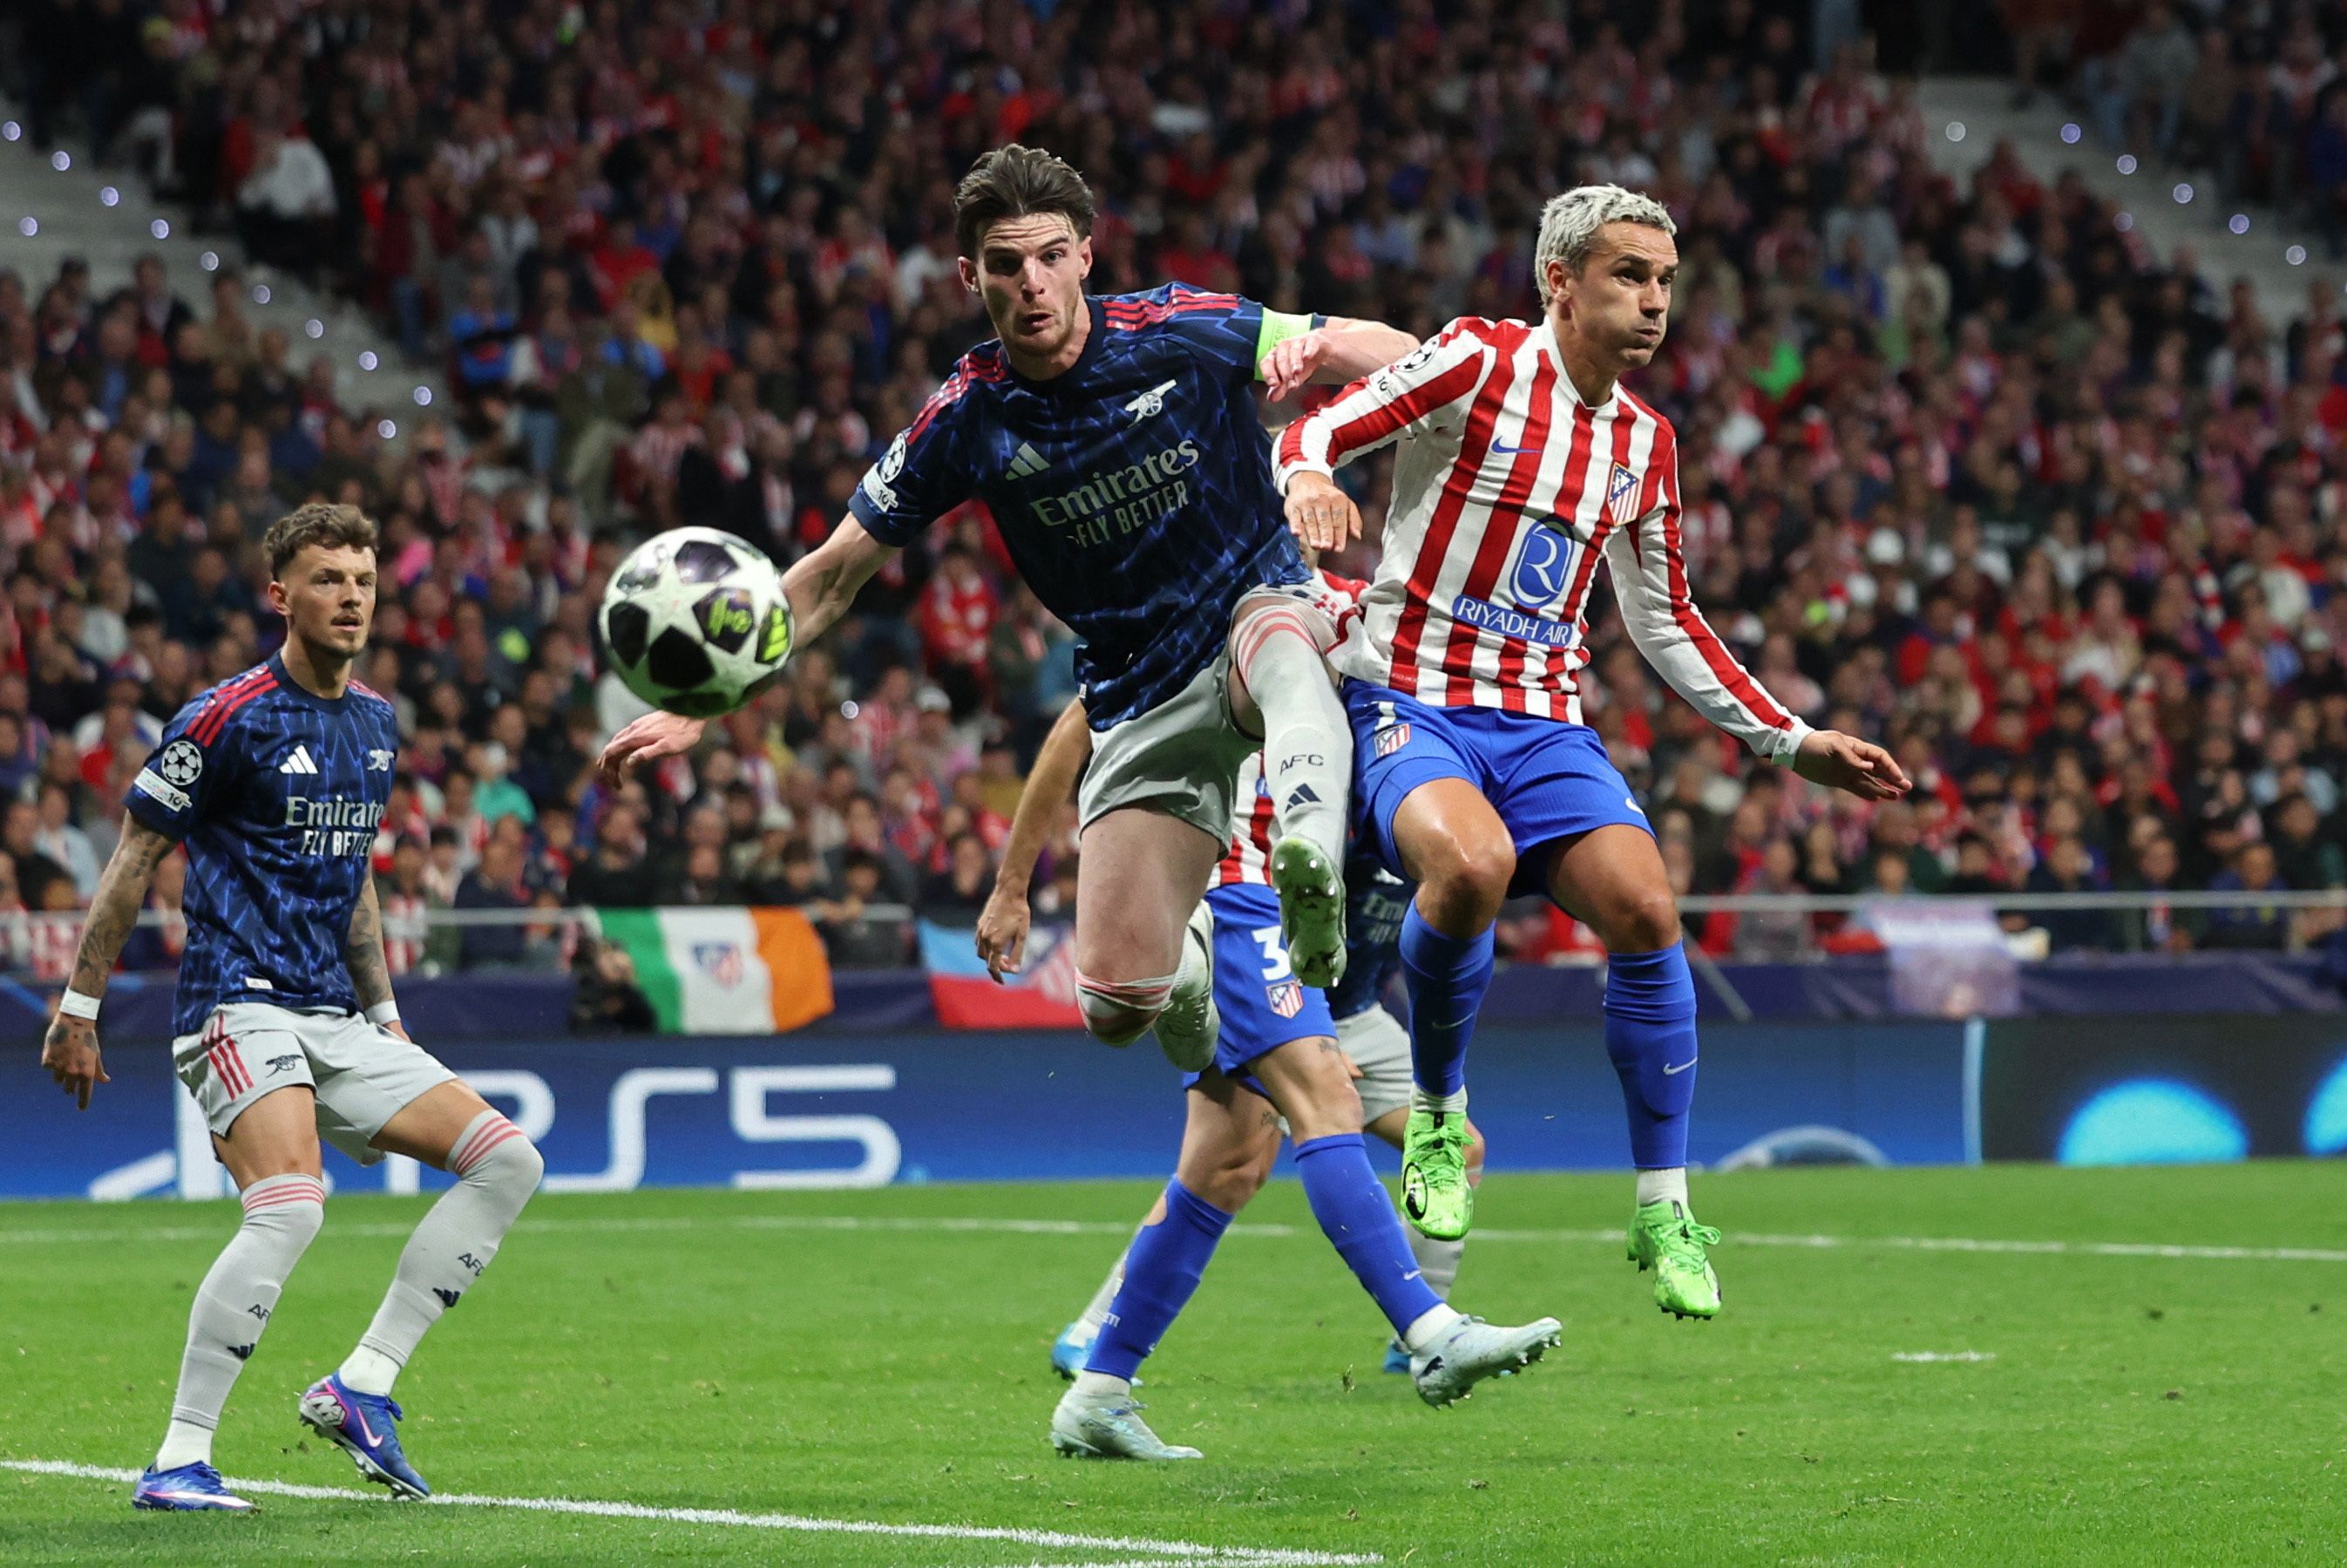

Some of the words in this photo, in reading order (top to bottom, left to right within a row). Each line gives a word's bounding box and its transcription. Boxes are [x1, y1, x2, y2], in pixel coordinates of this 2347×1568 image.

[1029, 439, 1199, 526] Emirates
[1076, 515, 1111, 548] FLY
[1115, 480, 1189, 534] BETTER
[1457, 598, 1540, 639] RIYADH
[1540, 624, 1569, 645] AIR
[1279, 754, 1324, 776] AFC
[301, 830, 329, 856] FLY
[1251, 925, 1292, 981] 3
